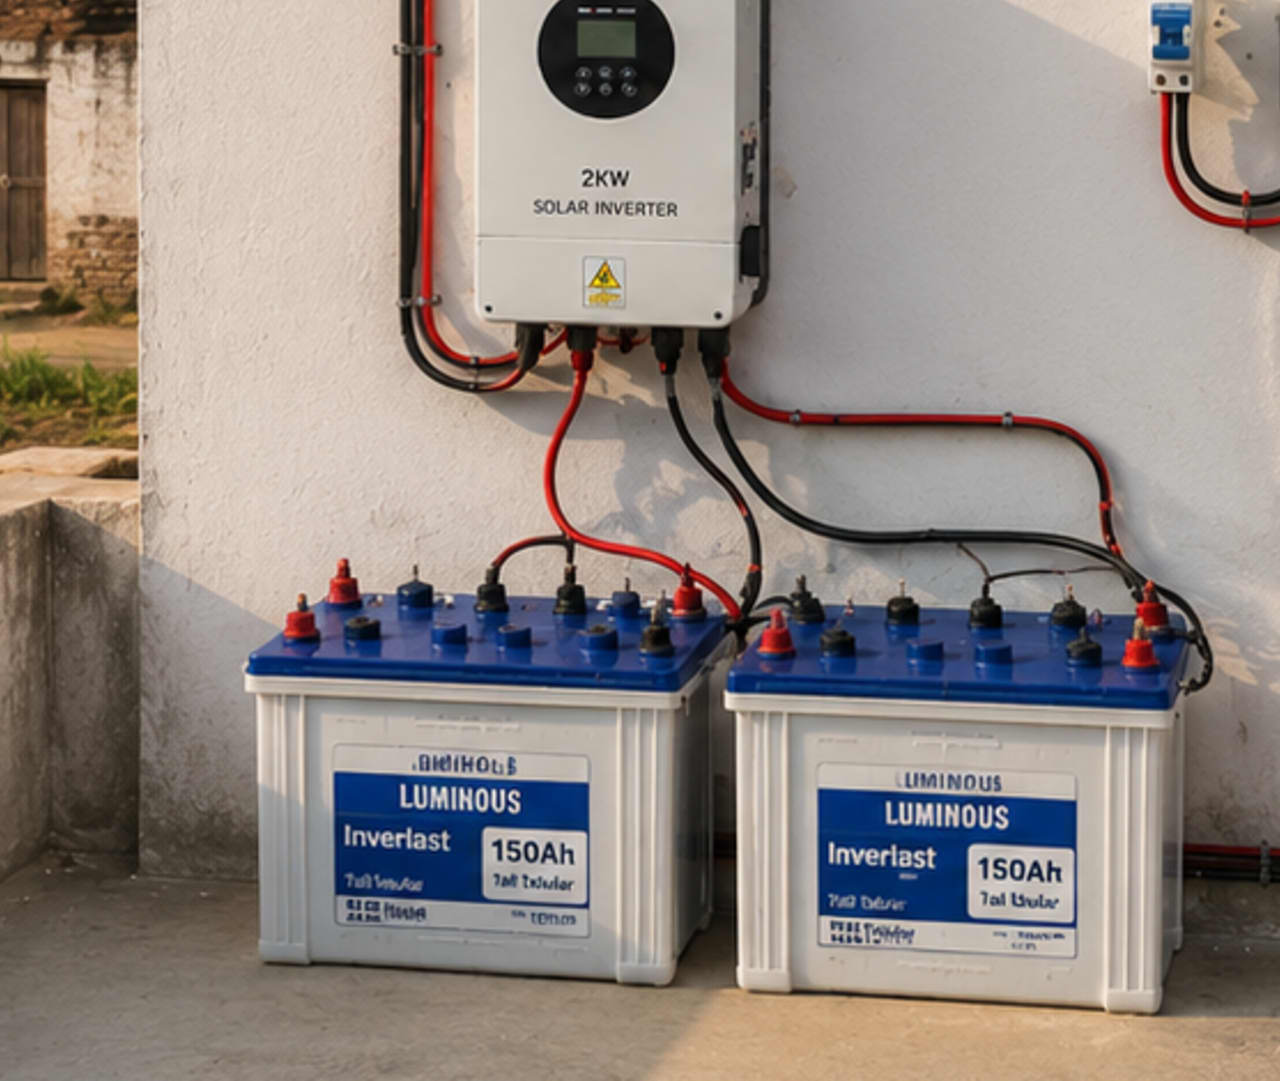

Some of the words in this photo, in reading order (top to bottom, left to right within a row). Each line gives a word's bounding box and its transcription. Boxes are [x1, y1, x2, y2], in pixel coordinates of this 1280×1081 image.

[581, 168, 630, 188] 2KW
[533, 199, 590, 215] SOLAR
[595, 201, 678, 217] INVERTER
[885, 800, 1010, 831] LUMINOUS
[344, 824, 452, 853] Inverlast
[491, 837, 576, 866] 150Ah
[827, 840, 937, 869] Inverlast
